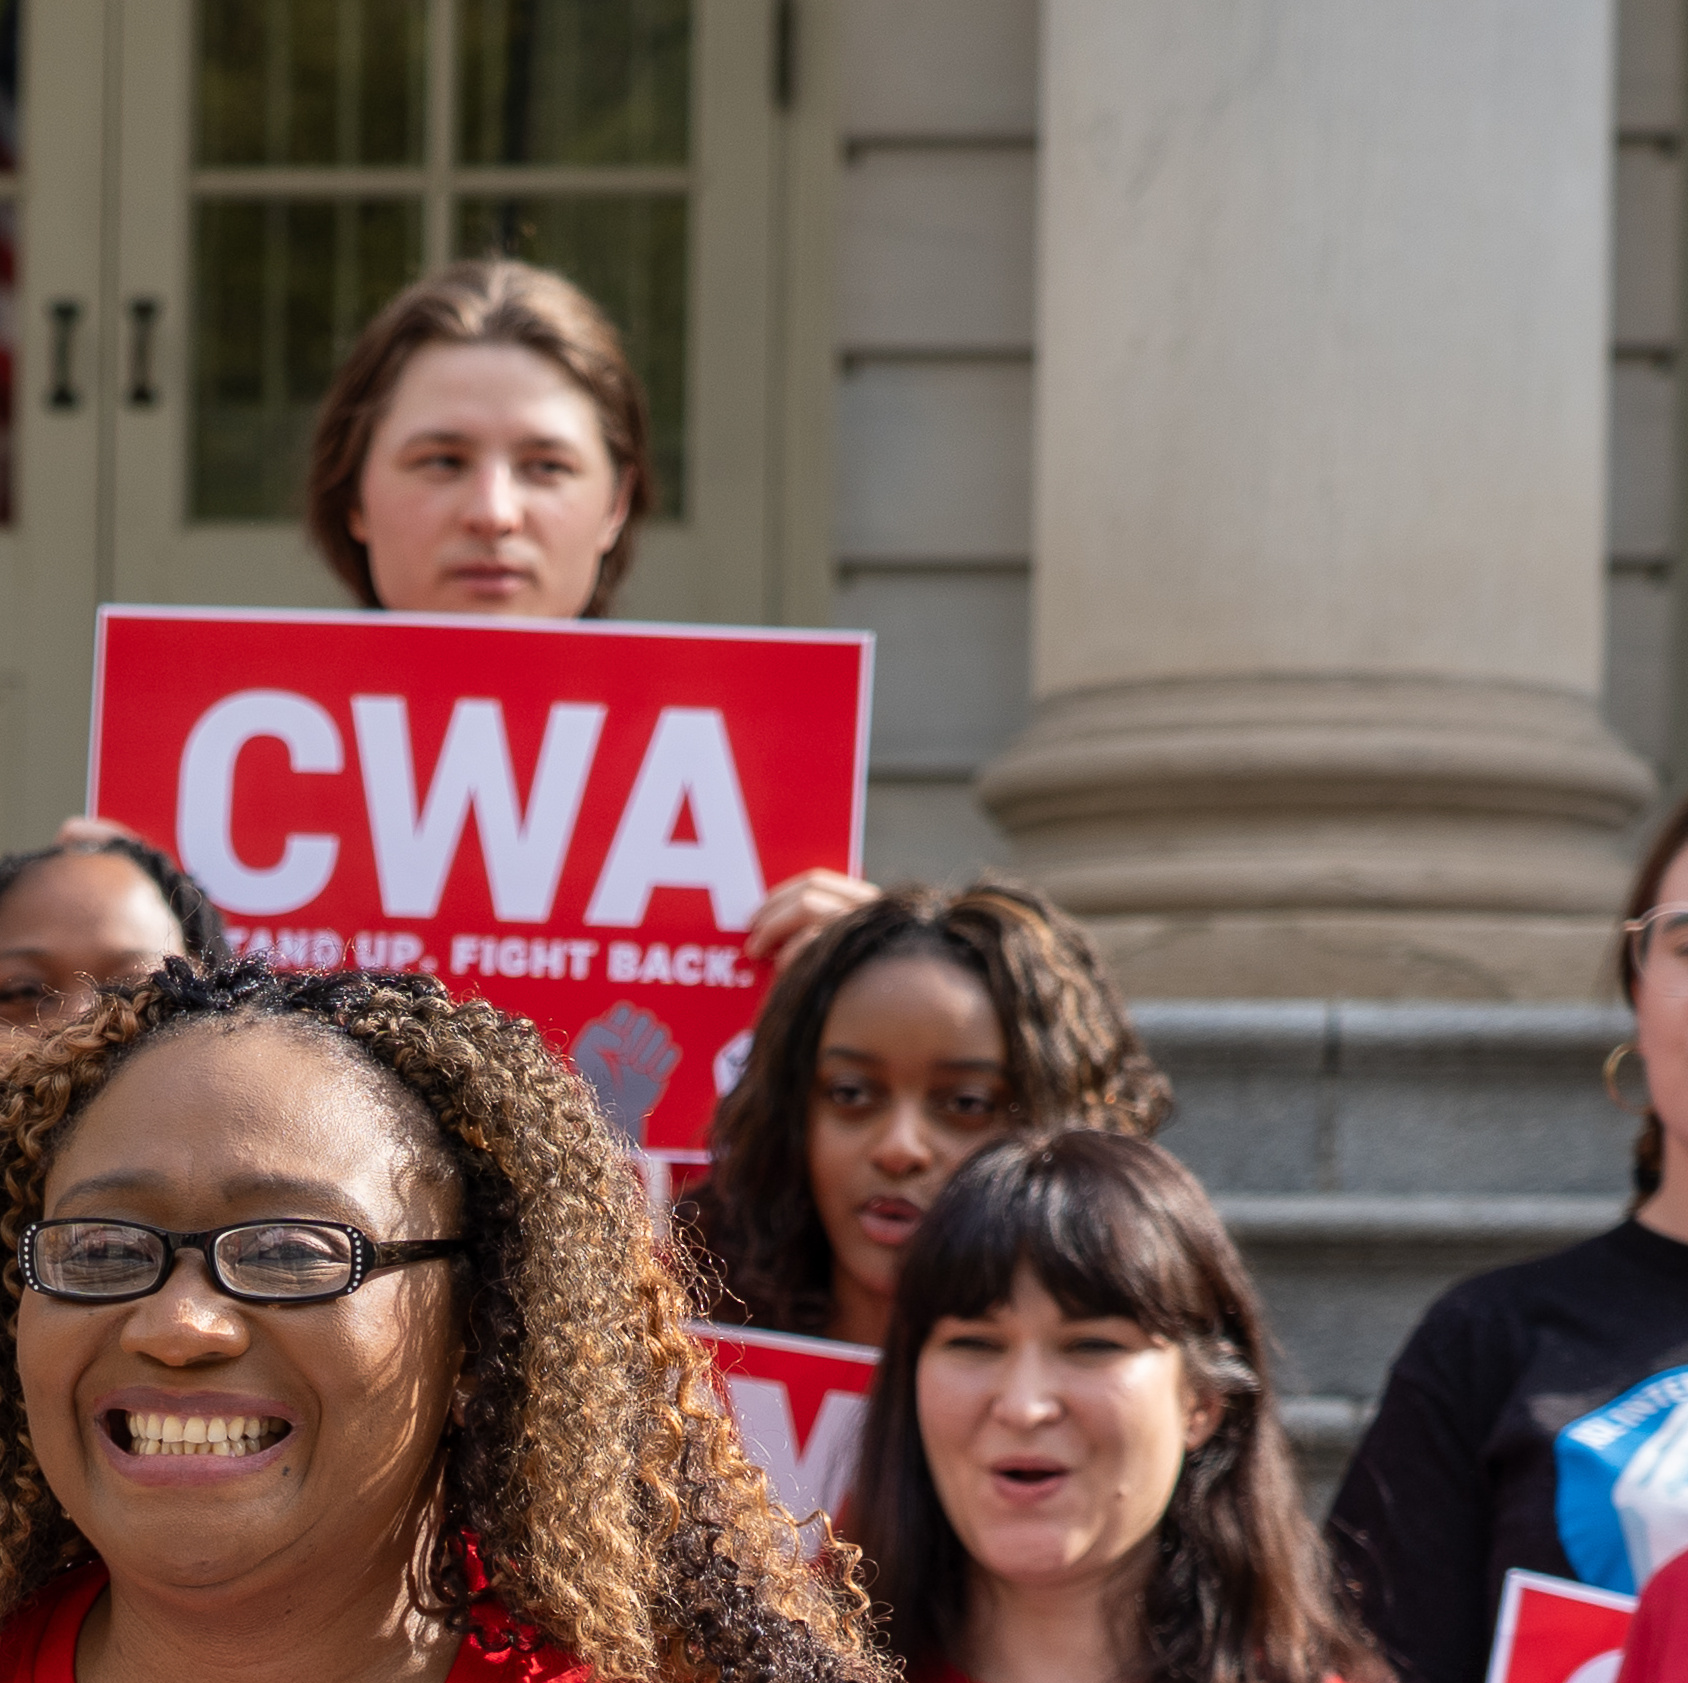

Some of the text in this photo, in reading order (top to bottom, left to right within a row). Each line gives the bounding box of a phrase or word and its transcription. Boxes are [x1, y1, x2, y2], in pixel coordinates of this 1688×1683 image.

[176, 688, 769, 933] CWA
[353, 927, 439, 975] UP.
[449, 932, 600, 982] FIGHT
[606, 940, 755, 989] BACK.
